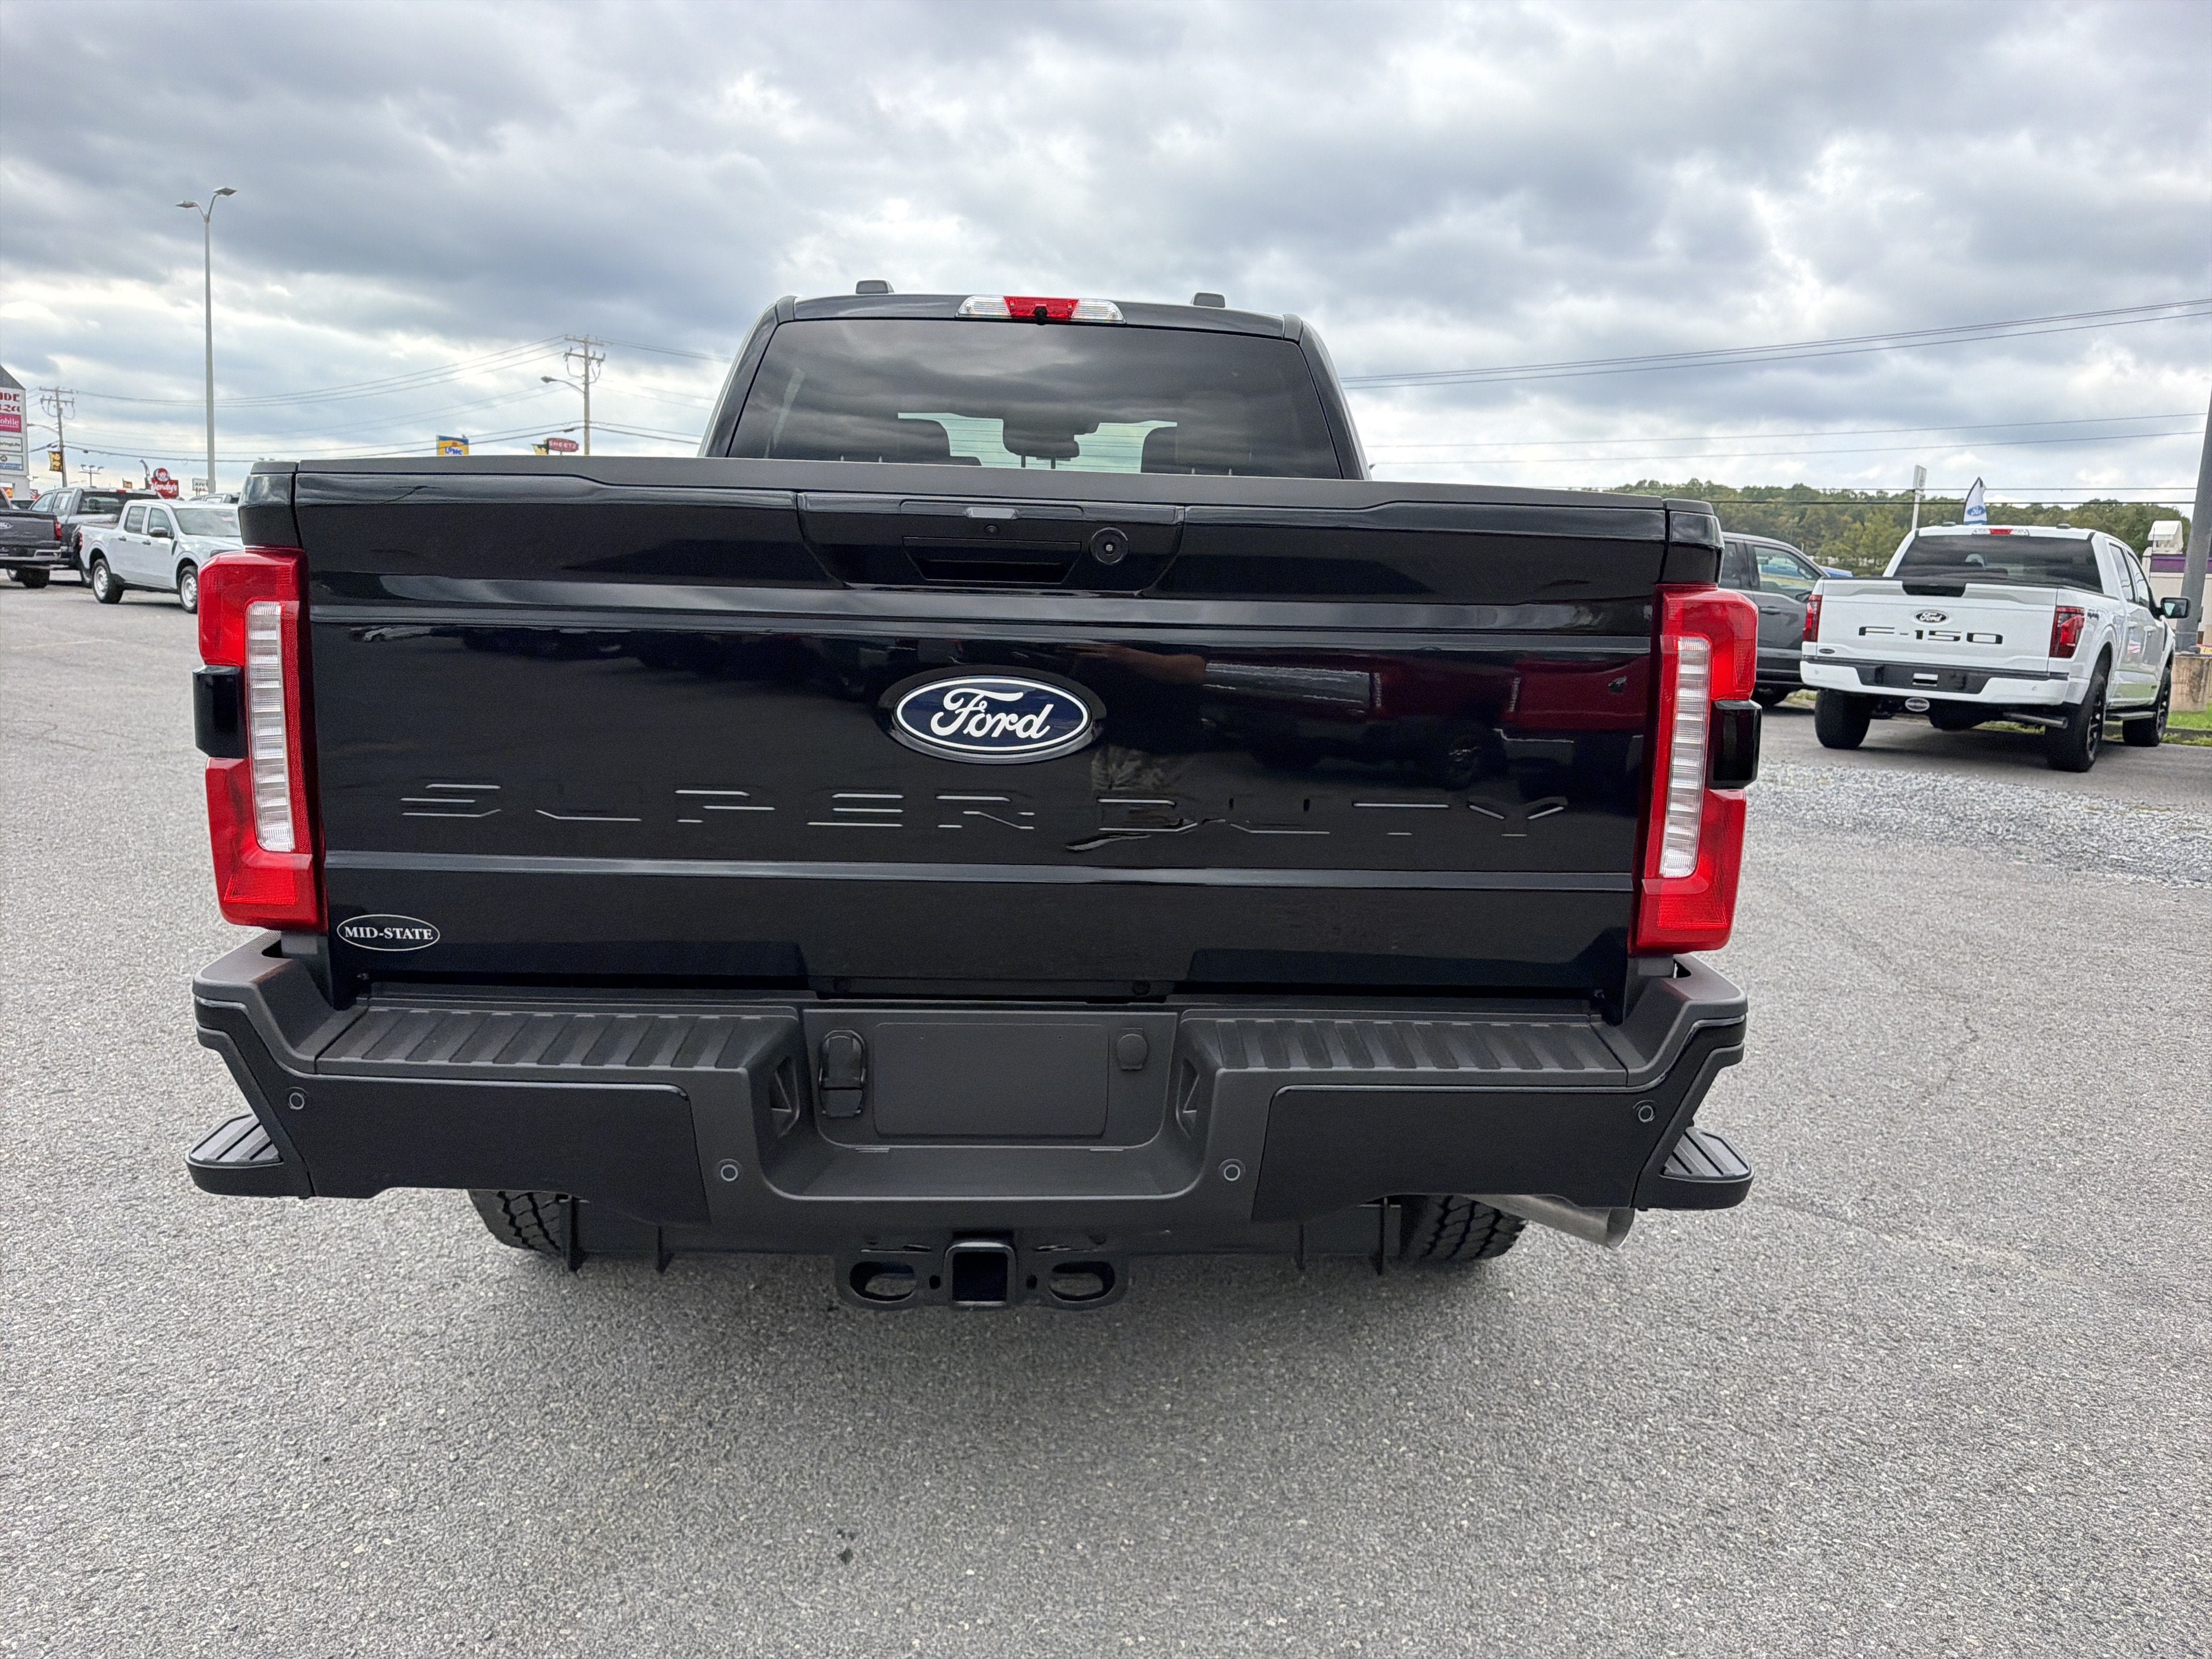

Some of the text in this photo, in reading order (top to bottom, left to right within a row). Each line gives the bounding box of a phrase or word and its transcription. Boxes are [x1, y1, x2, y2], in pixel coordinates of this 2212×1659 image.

[1920, 611, 1943, 621] Ford
[1858, 626, 2004, 645] F-150
[930, 687, 1054, 739] Ford
[399, 778, 1036, 830] SUPER
[344, 926, 433, 940] MID-STATE
